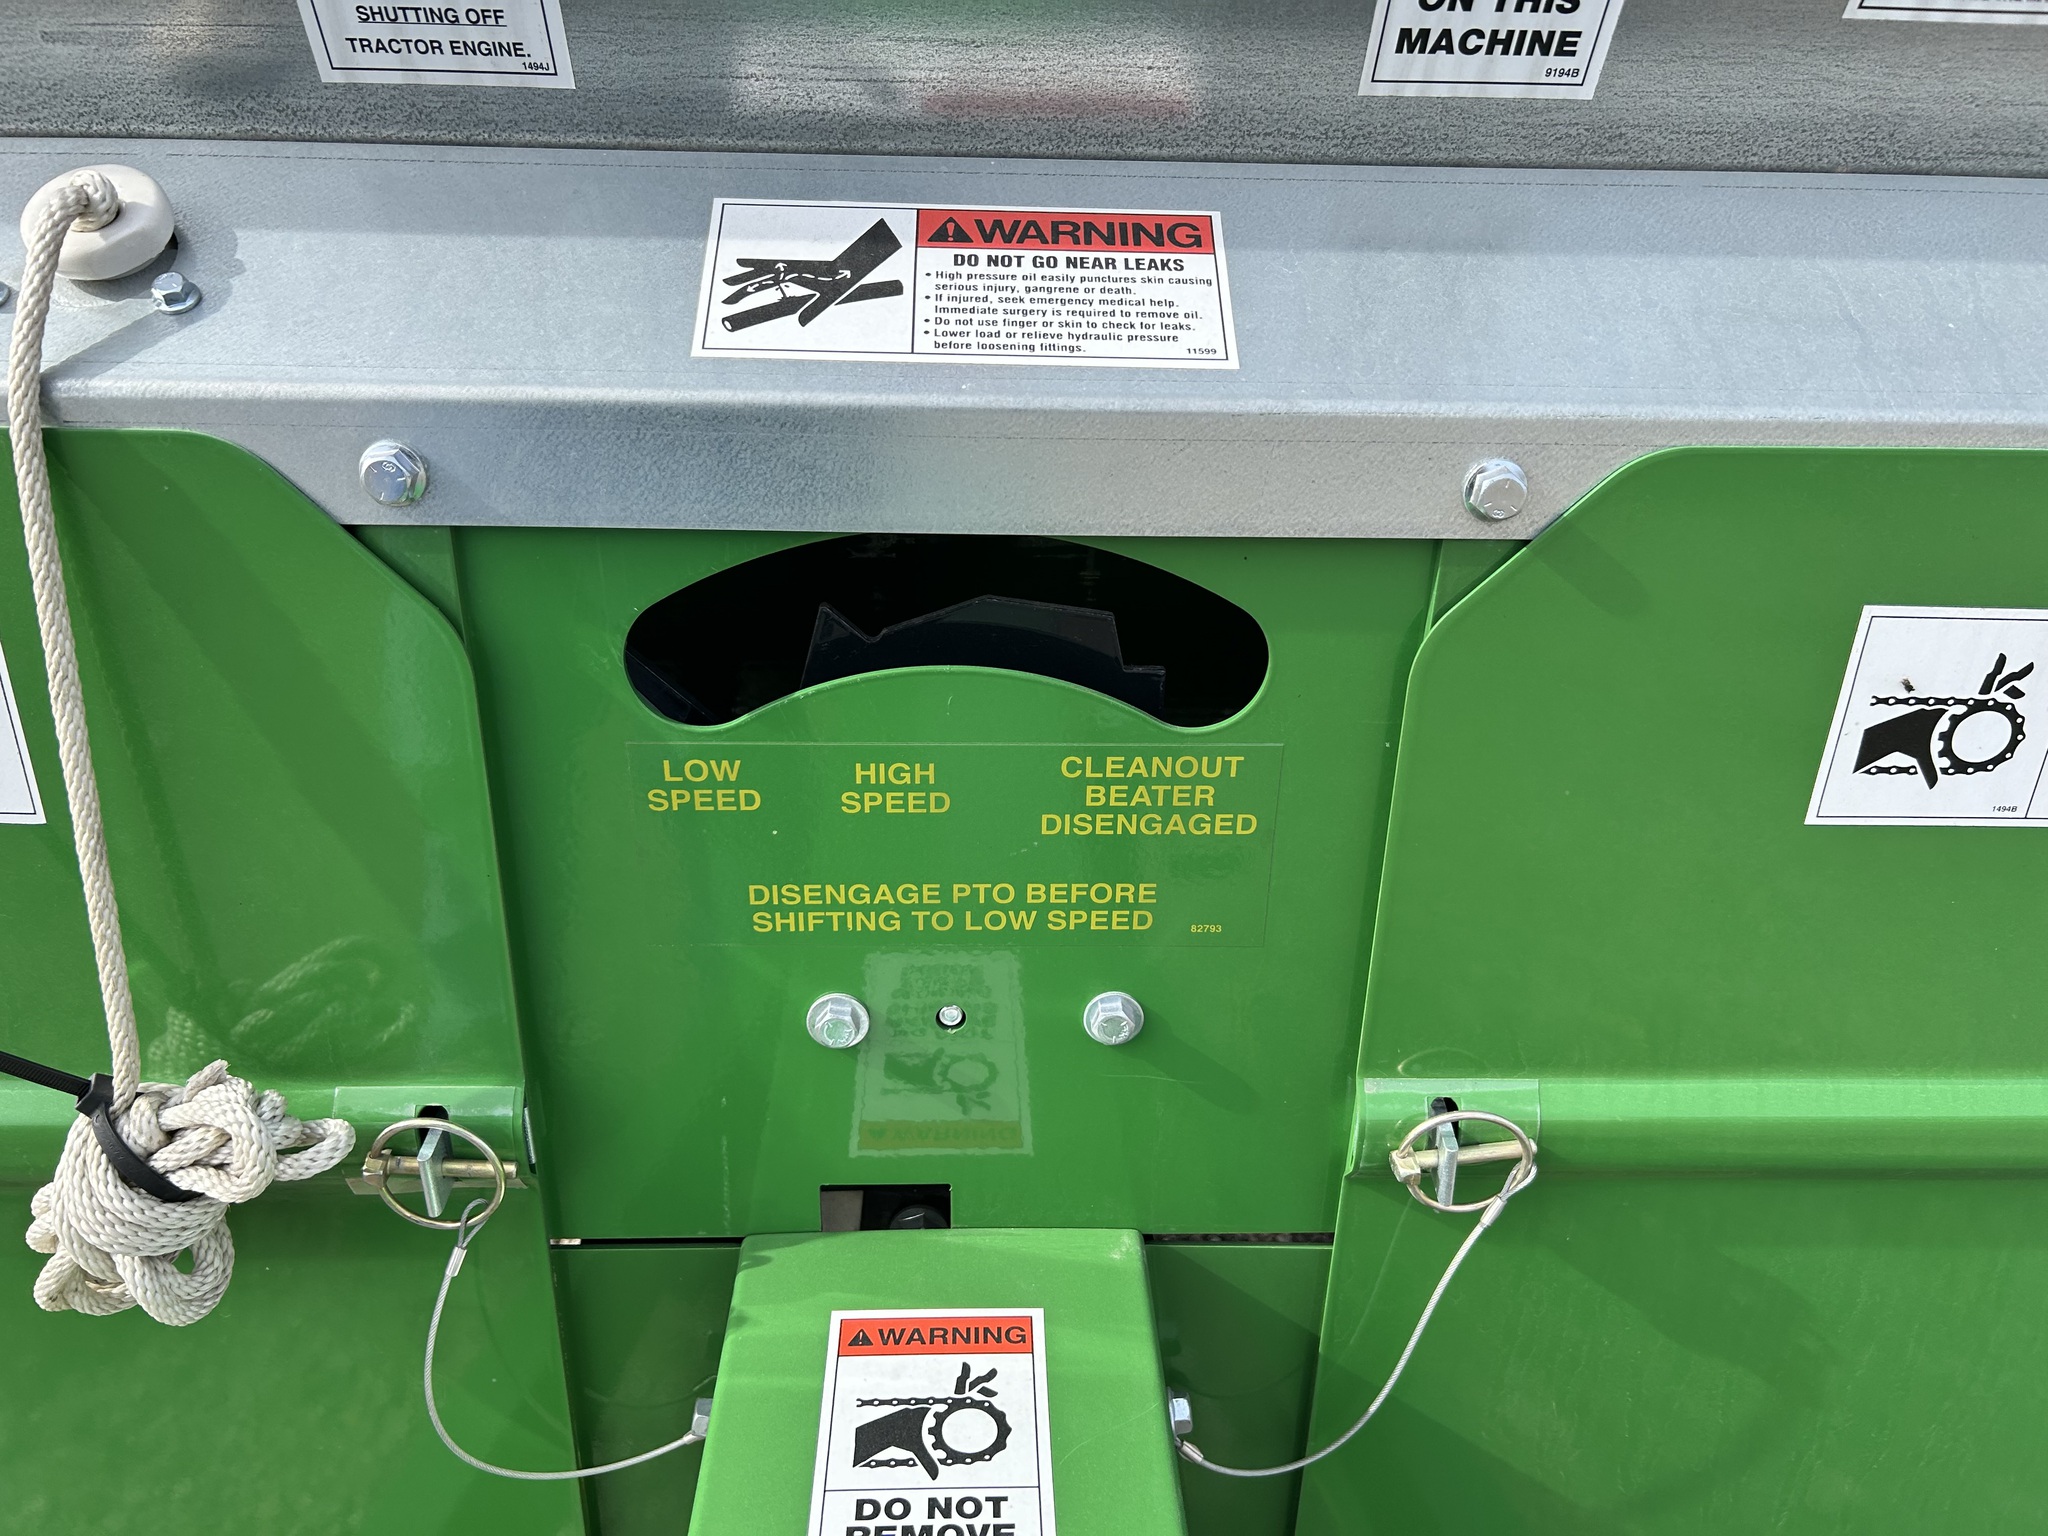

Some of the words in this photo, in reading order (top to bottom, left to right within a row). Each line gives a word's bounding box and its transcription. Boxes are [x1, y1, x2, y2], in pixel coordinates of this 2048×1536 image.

[356, 5, 459, 24] SHUTTING
[465, 8, 504, 24] OFF
[345, 38, 444, 55] TRACTOR
[449, 41, 531, 57] ENGINE.
[1395, 28, 1582, 57] MACHINE
[522, 62, 549, 71] 1494J
[1545, 68, 1579, 77] 9194B
[974, 219, 1202, 248] WARNING
[954, 254, 979, 266] DO
[987, 255, 1025, 267] NOT
[1032, 256, 1058, 268] GO
[1066, 256, 1116, 269] NEAR
[1124, 258, 1184, 271] LEAKS
[936, 271, 962, 280] High
[1022, 273, 1036, 281] oil
[1041, 274, 1075, 283] easily
[1080, 275, 1136, 283] punctures
[1169, 278, 1212, 286] causing
[983, 285, 1019, 293] injury,
[1025, 286, 1079, 294] gangrene
[1100, 286, 1136, 294] death.
[948, 295, 992, 304] injured,
[1030, 298, 1093, 307] emergency
[1099, 298, 1145, 306] medical
[1150, 299, 1179, 308] help.
[935, 305, 998, 314] Immediate
[1003, 309, 1047, 317] surgery
[1067, 309, 1115, 318] required
[1184, 311, 1202, 319] oil.
[935, 317, 950, 325] Do
[1003, 319, 1037, 328] finger
[1058, 320, 1082, 328] skin
[1102, 321, 1135, 329] check
[1161, 322, 1196, 330] leaks.
[935, 329, 970, 337] Lower
[976, 330, 1000, 338] load
[1022, 331, 1062, 339] relieve
[1068, 332, 1122, 341] hydraulic
[934, 341, 971, 349] before
[978, 342, 1035, 352] loosening
[1040, 343, 1086, 353] fittings.
[664, 759, 740, 782] LOW
[856, 763, 934, 784] HIGH
[1061, 756, 1244, 778] CLEANOUT
[648, 789, 761, 811] SPEED
[841, 792, 950, 813] SPEED
[1086, 786, 1214, 806] BEATER
[1042, 814, 1257, 835] DISENGAGED
[749, 884, 940, 905] DISENGAGE
[953, 883, 1015, 904] PTO
[1026, 883, 1156, 903] BEFORE
[753, 911, 900, 932] SHIFTING
[912, 911, 953, 931] TO
[966, 910, 1037, 930] LOW
[1048, 910, 1152, 930] SPEED
[1190, 924, 1222, 933] 82793
[878, 1326, 1026, 1345] WARNING
[855, 1498, 911, 1520] DO
[928, 1496, 1008, 1519] NOT
